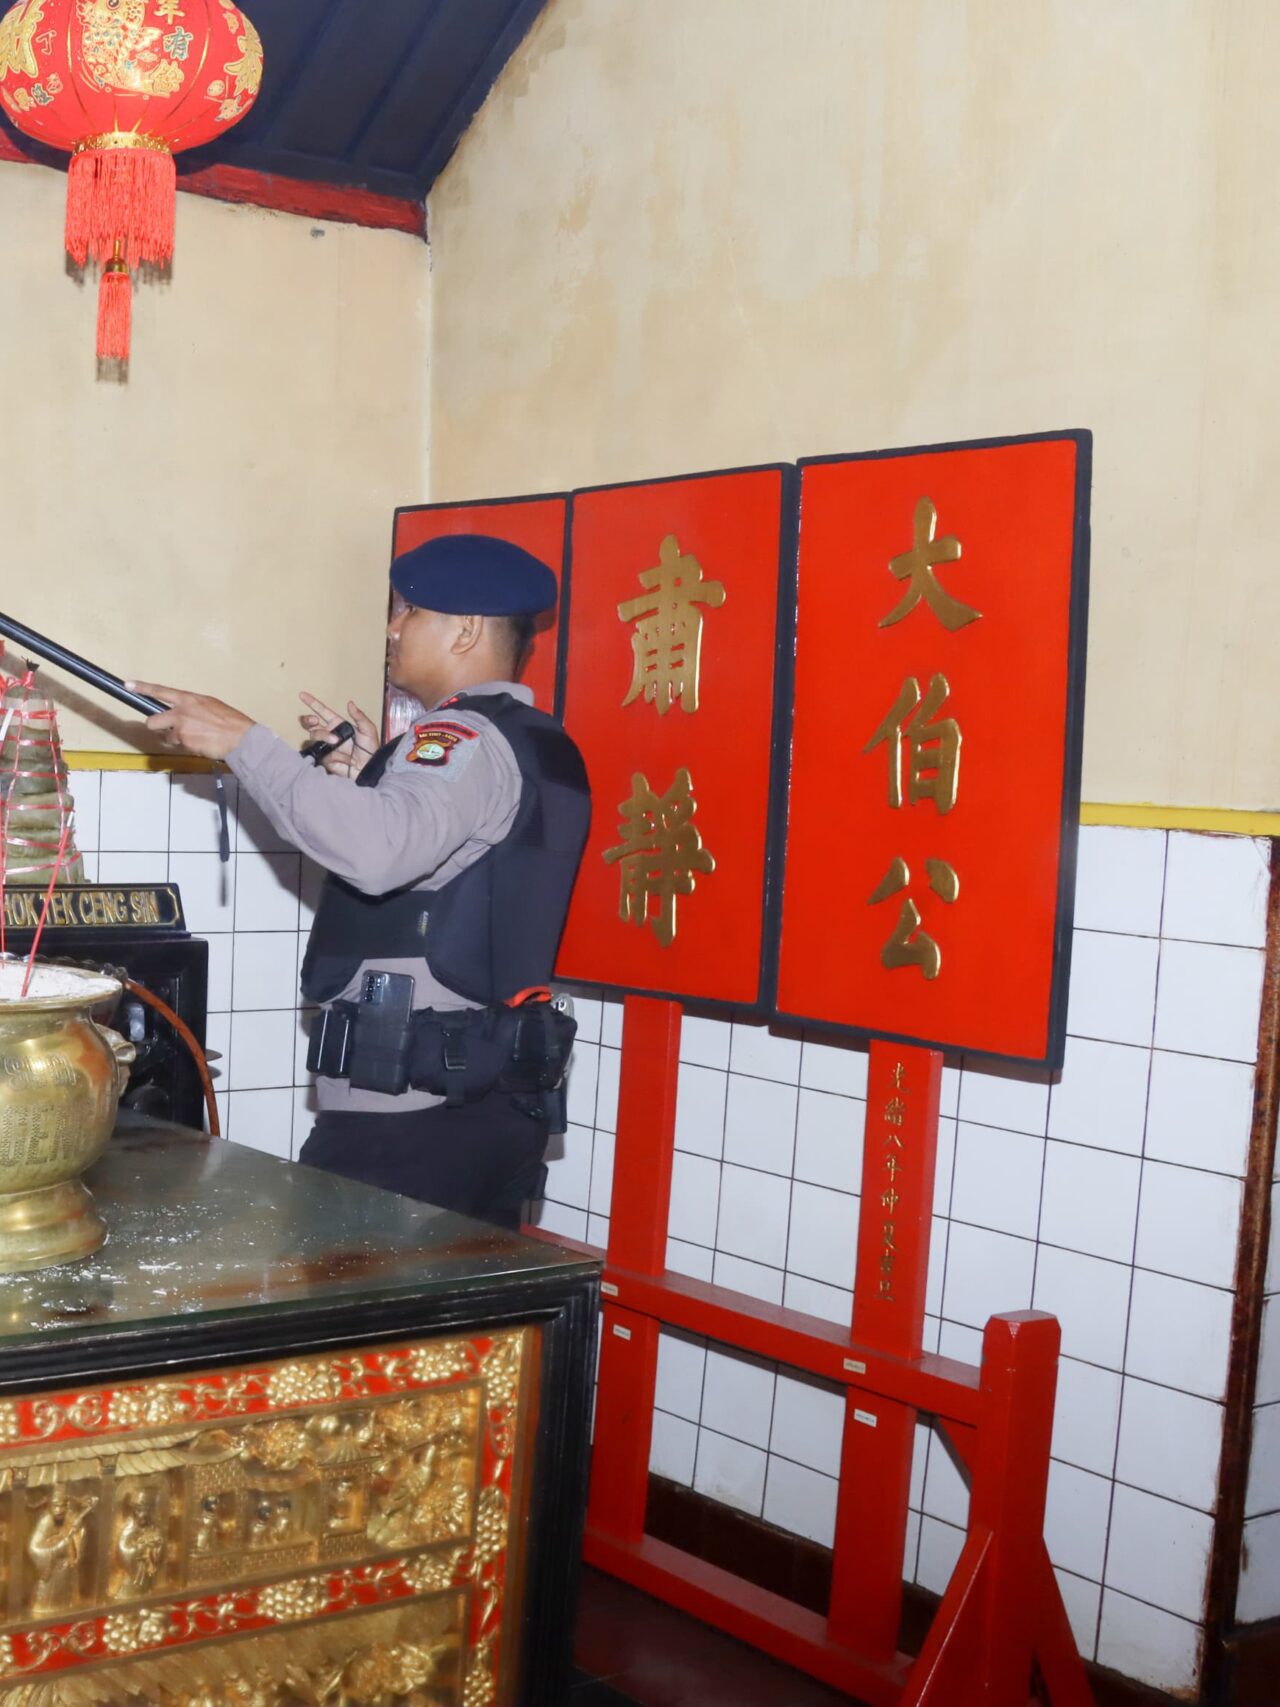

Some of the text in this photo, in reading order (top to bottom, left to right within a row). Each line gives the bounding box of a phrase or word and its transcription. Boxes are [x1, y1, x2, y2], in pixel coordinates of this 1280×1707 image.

[863, 496, 983, 980] 大伯公
[40, 892, 78, 926] TEK
[79, 891, 128, 925] CENG
[130, 891, 160, 924] SIN
